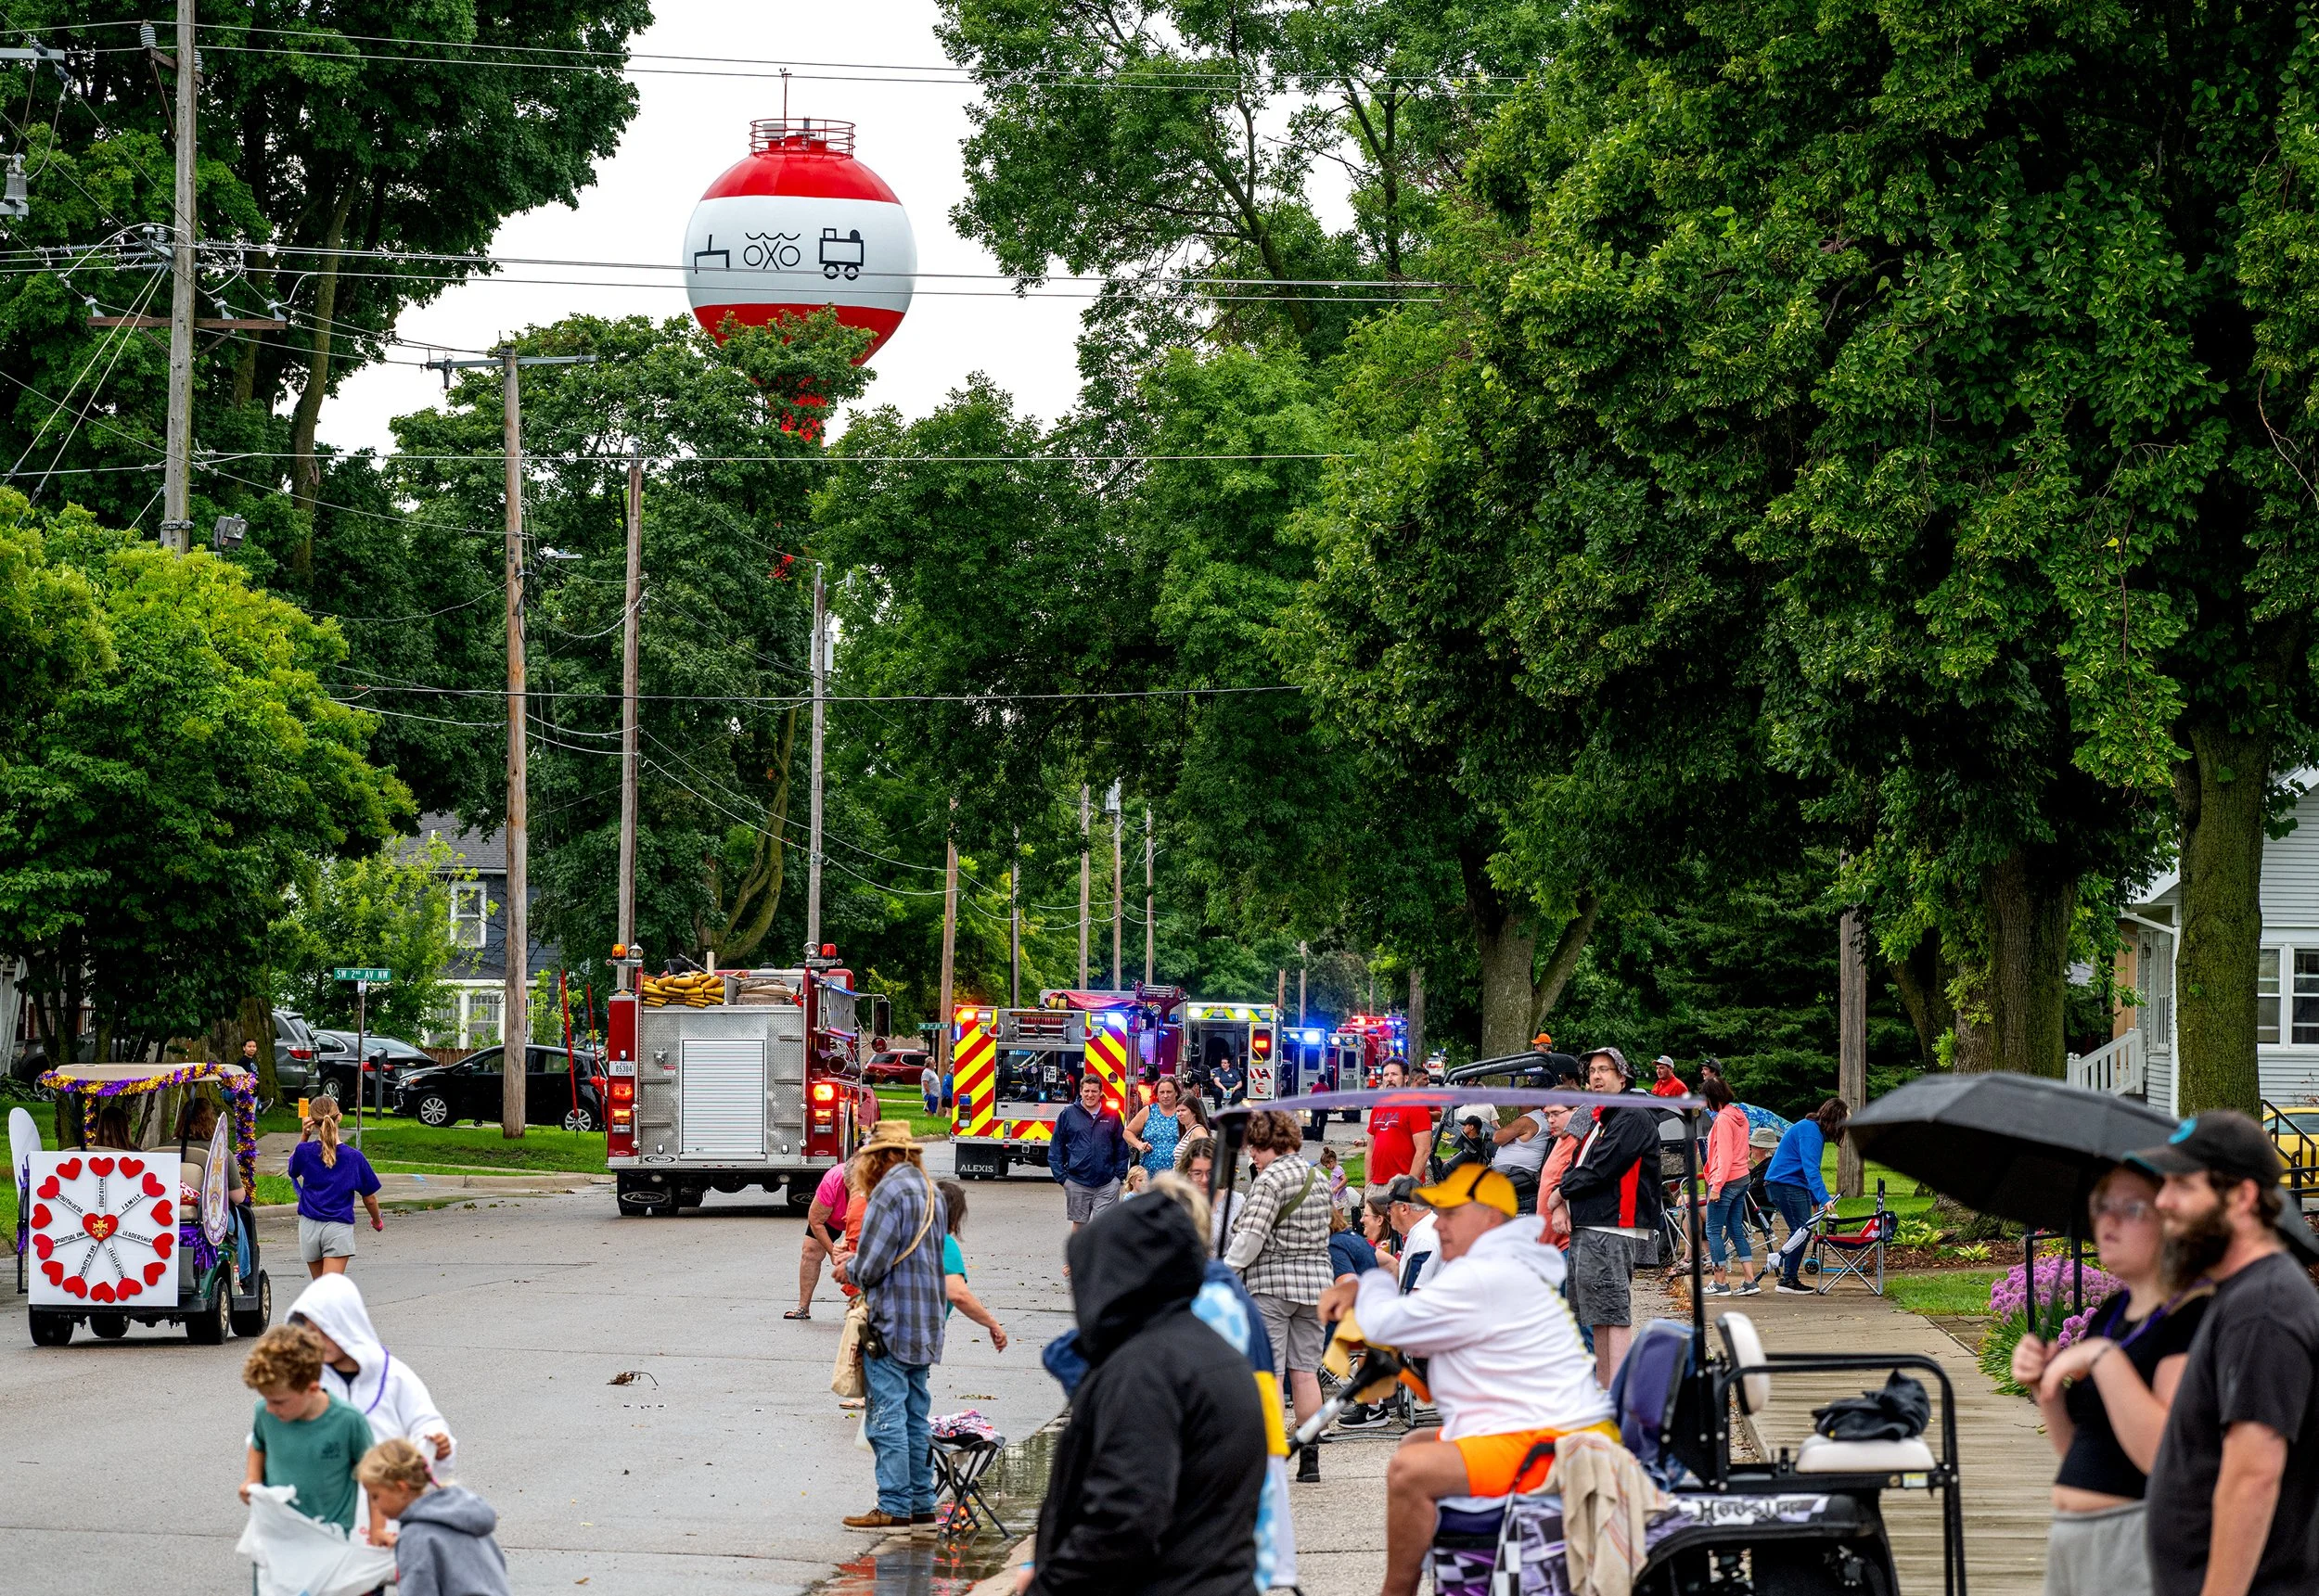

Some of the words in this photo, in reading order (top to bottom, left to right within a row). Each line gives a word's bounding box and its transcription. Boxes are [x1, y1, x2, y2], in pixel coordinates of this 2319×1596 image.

[337, 970, 347, 978] SW
[351, 970, 361, 978] 2ND
[365, 971, 374, 979] AV
[378, 971, 389, 979] NW
[959, 1164, 993, 1172] ALEXIS
[630, 1191, 660, 1200] Pierce
[122, 1194, 141, 1210] FAMILY
[54, 1234, 75, 1245] SPIRITUAL
[122, 1230, 153, 1244] LEADERSHIP
[78, 1258, 90, 1277] QUALITY
[108, 1247, 125, 1279] LEGISLATION
